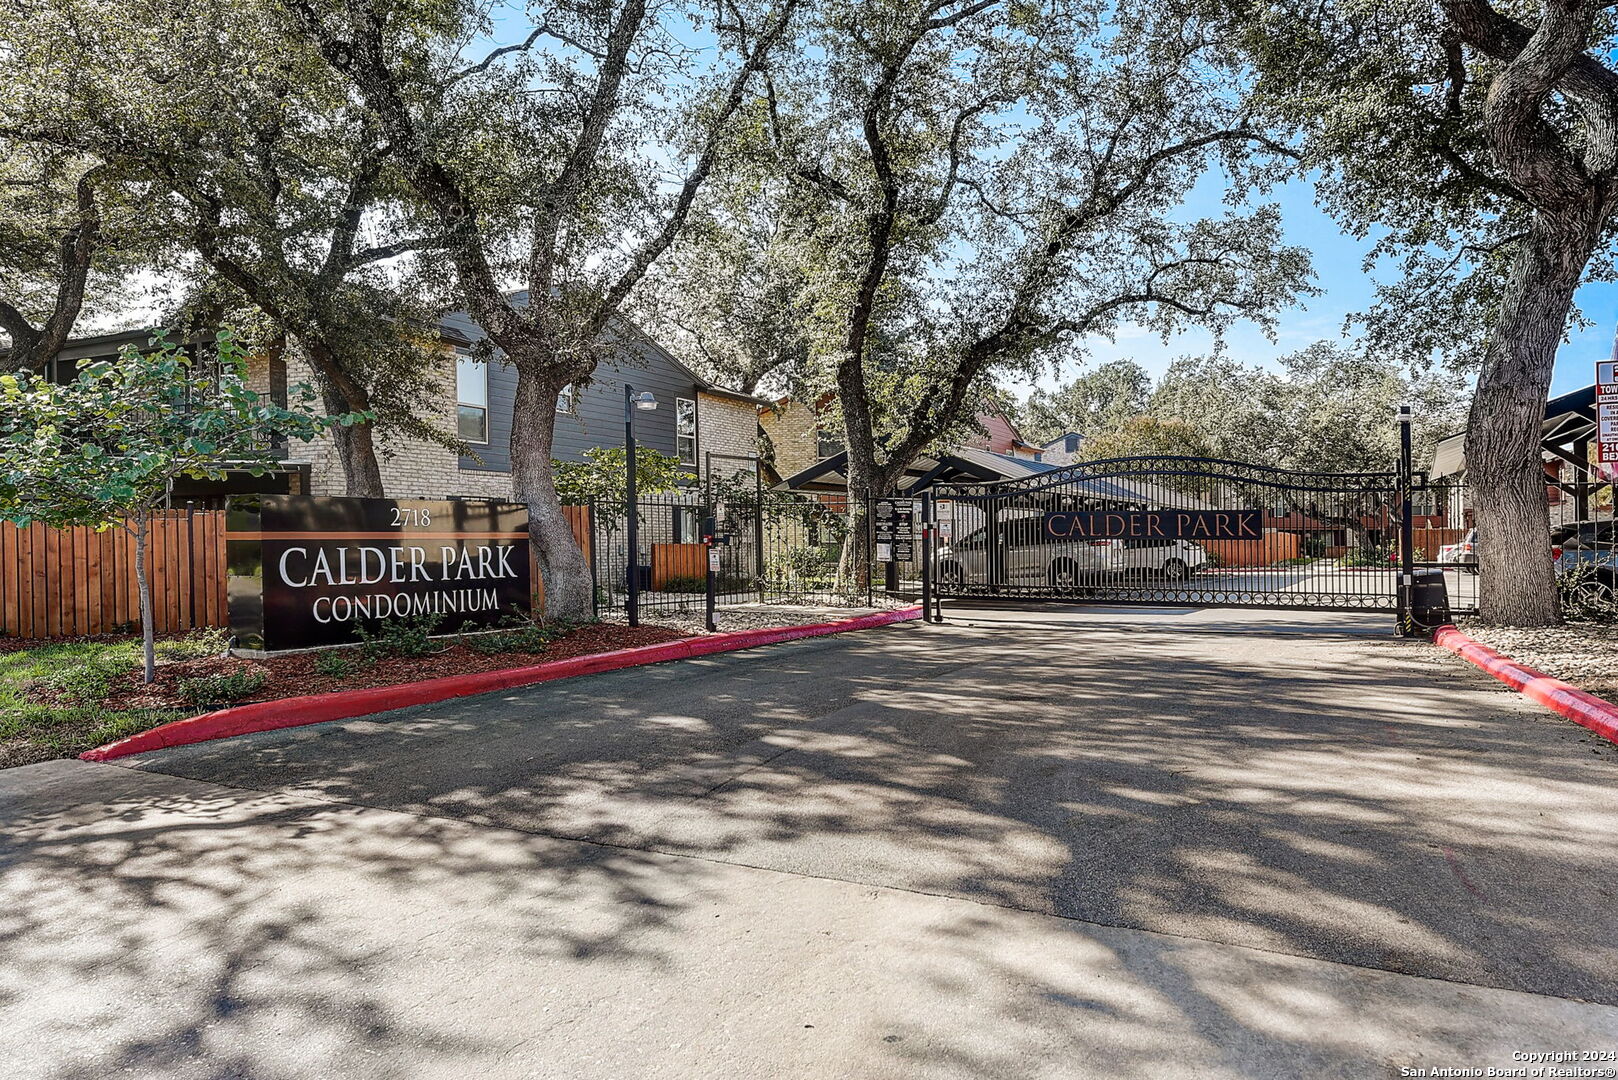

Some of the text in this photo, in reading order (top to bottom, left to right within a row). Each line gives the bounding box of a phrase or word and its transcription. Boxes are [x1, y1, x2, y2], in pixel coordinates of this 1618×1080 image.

[390, 507, 431, 527] 2718
[1048, 513, 1257, 537] CALDER PARK
[279, 545, 518, 588] CALDER PARK
[312, 588, 500, 624] CONDOMINIUM
